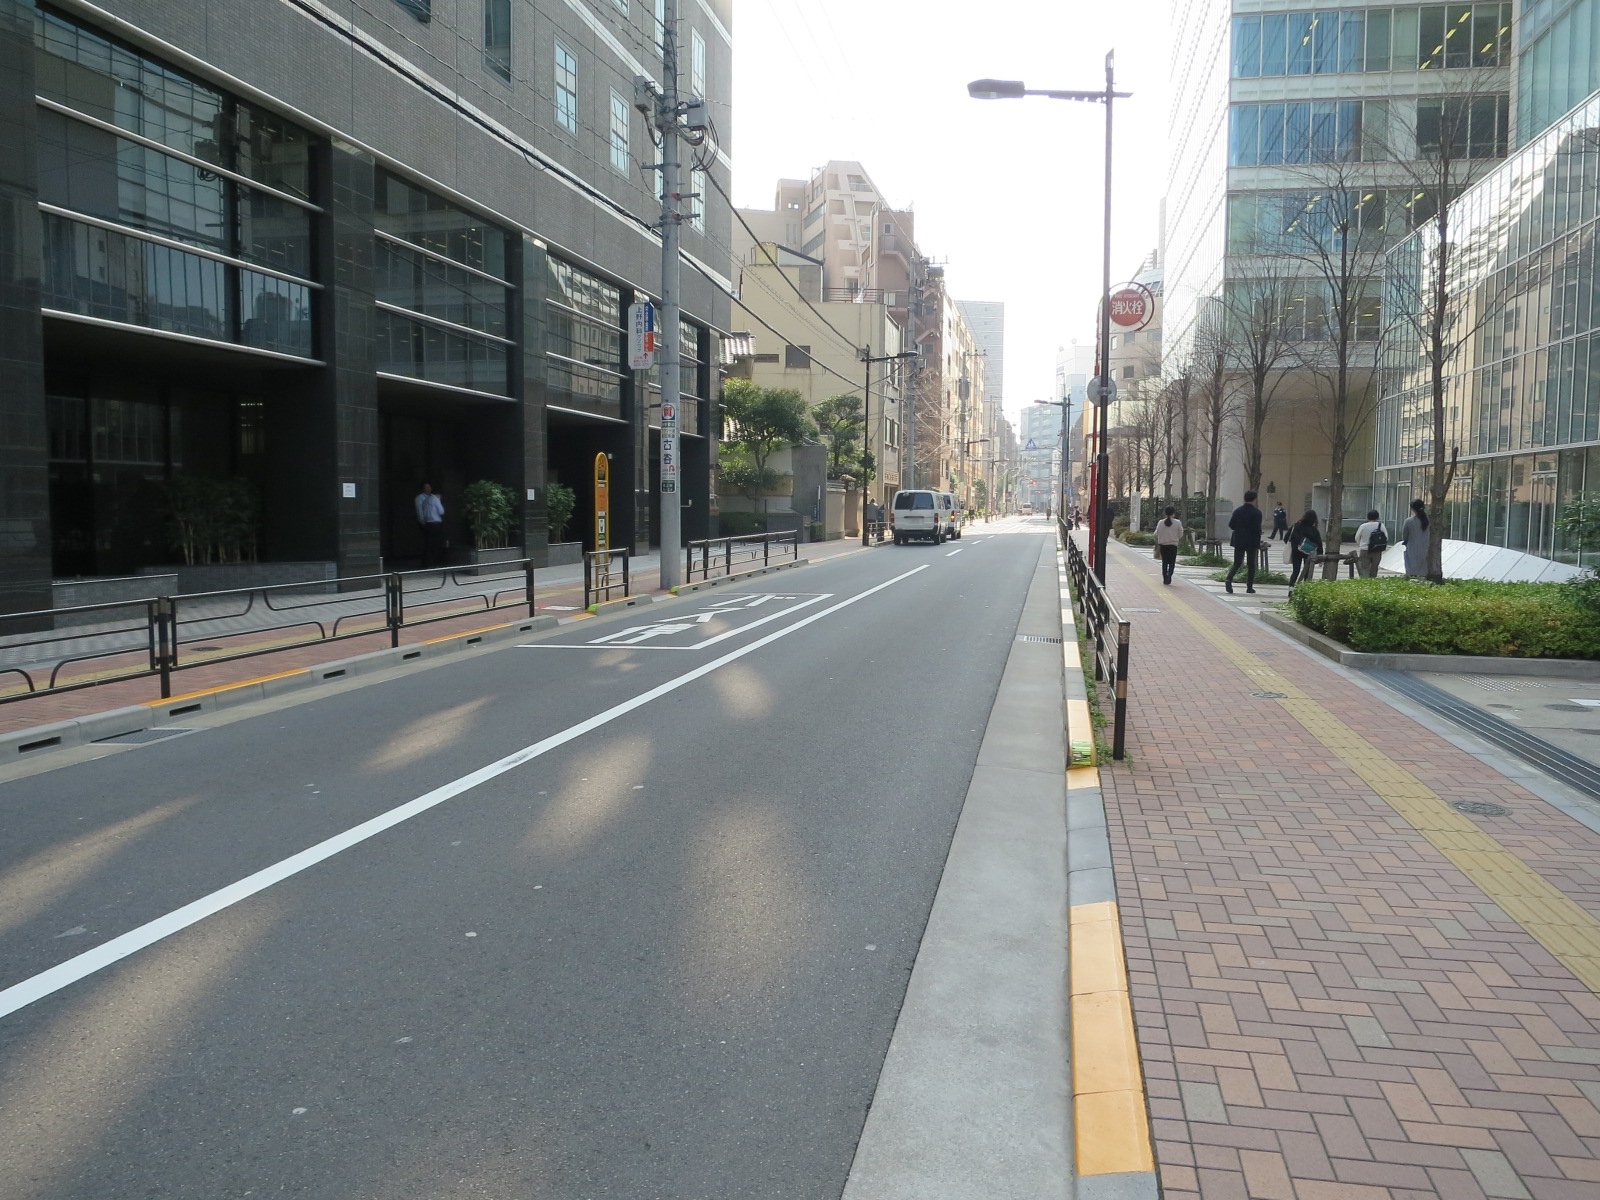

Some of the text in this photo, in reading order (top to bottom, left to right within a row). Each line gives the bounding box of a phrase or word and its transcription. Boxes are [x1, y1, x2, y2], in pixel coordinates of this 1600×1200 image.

[1111, 300, 1143, 315] 消火栓
[663, 438, 672, 465] 古谷
[585, 594, 796, 645] バス停
